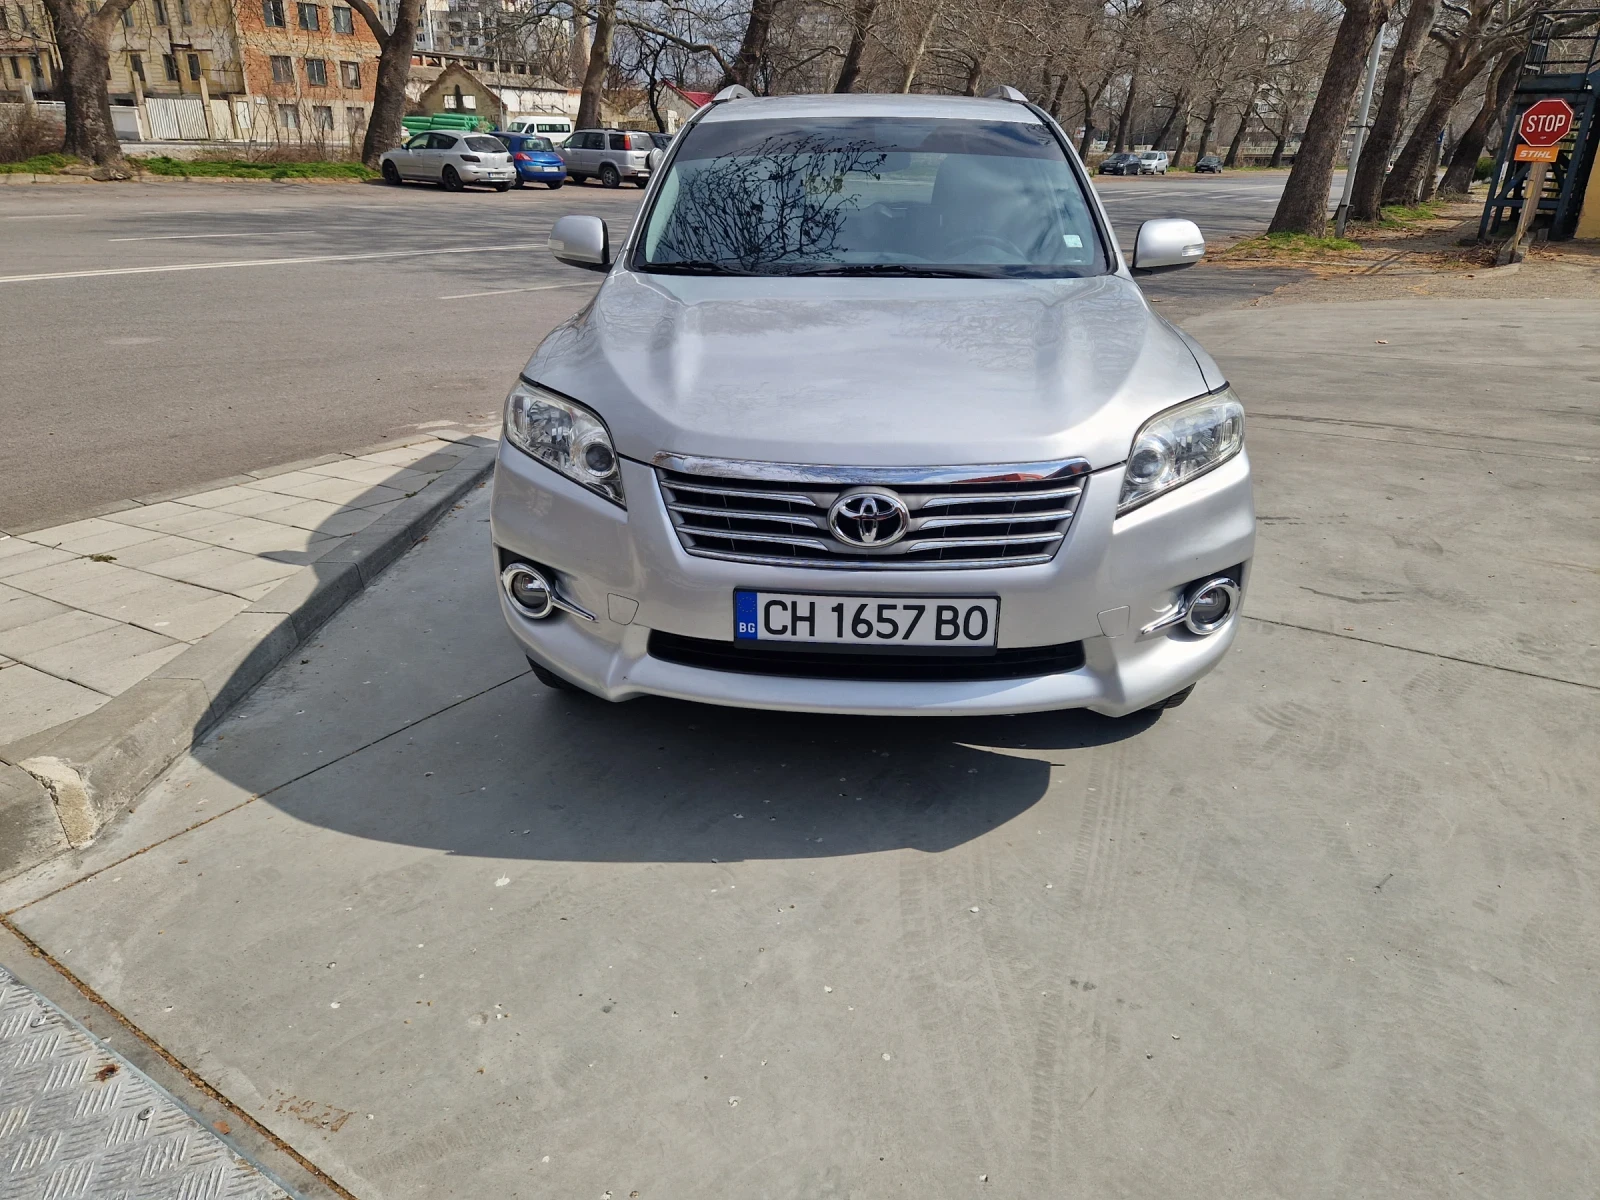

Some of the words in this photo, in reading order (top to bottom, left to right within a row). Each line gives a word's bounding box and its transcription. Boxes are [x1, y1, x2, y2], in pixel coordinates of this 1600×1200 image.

[1526, 114, 1566, 132] STOP
[1519, 150, 1552, 159] STIHL
[764, 600, 815, 637] CH
[831, 603, 926, 640] 1657
[739, 622, 756, 633] BG
